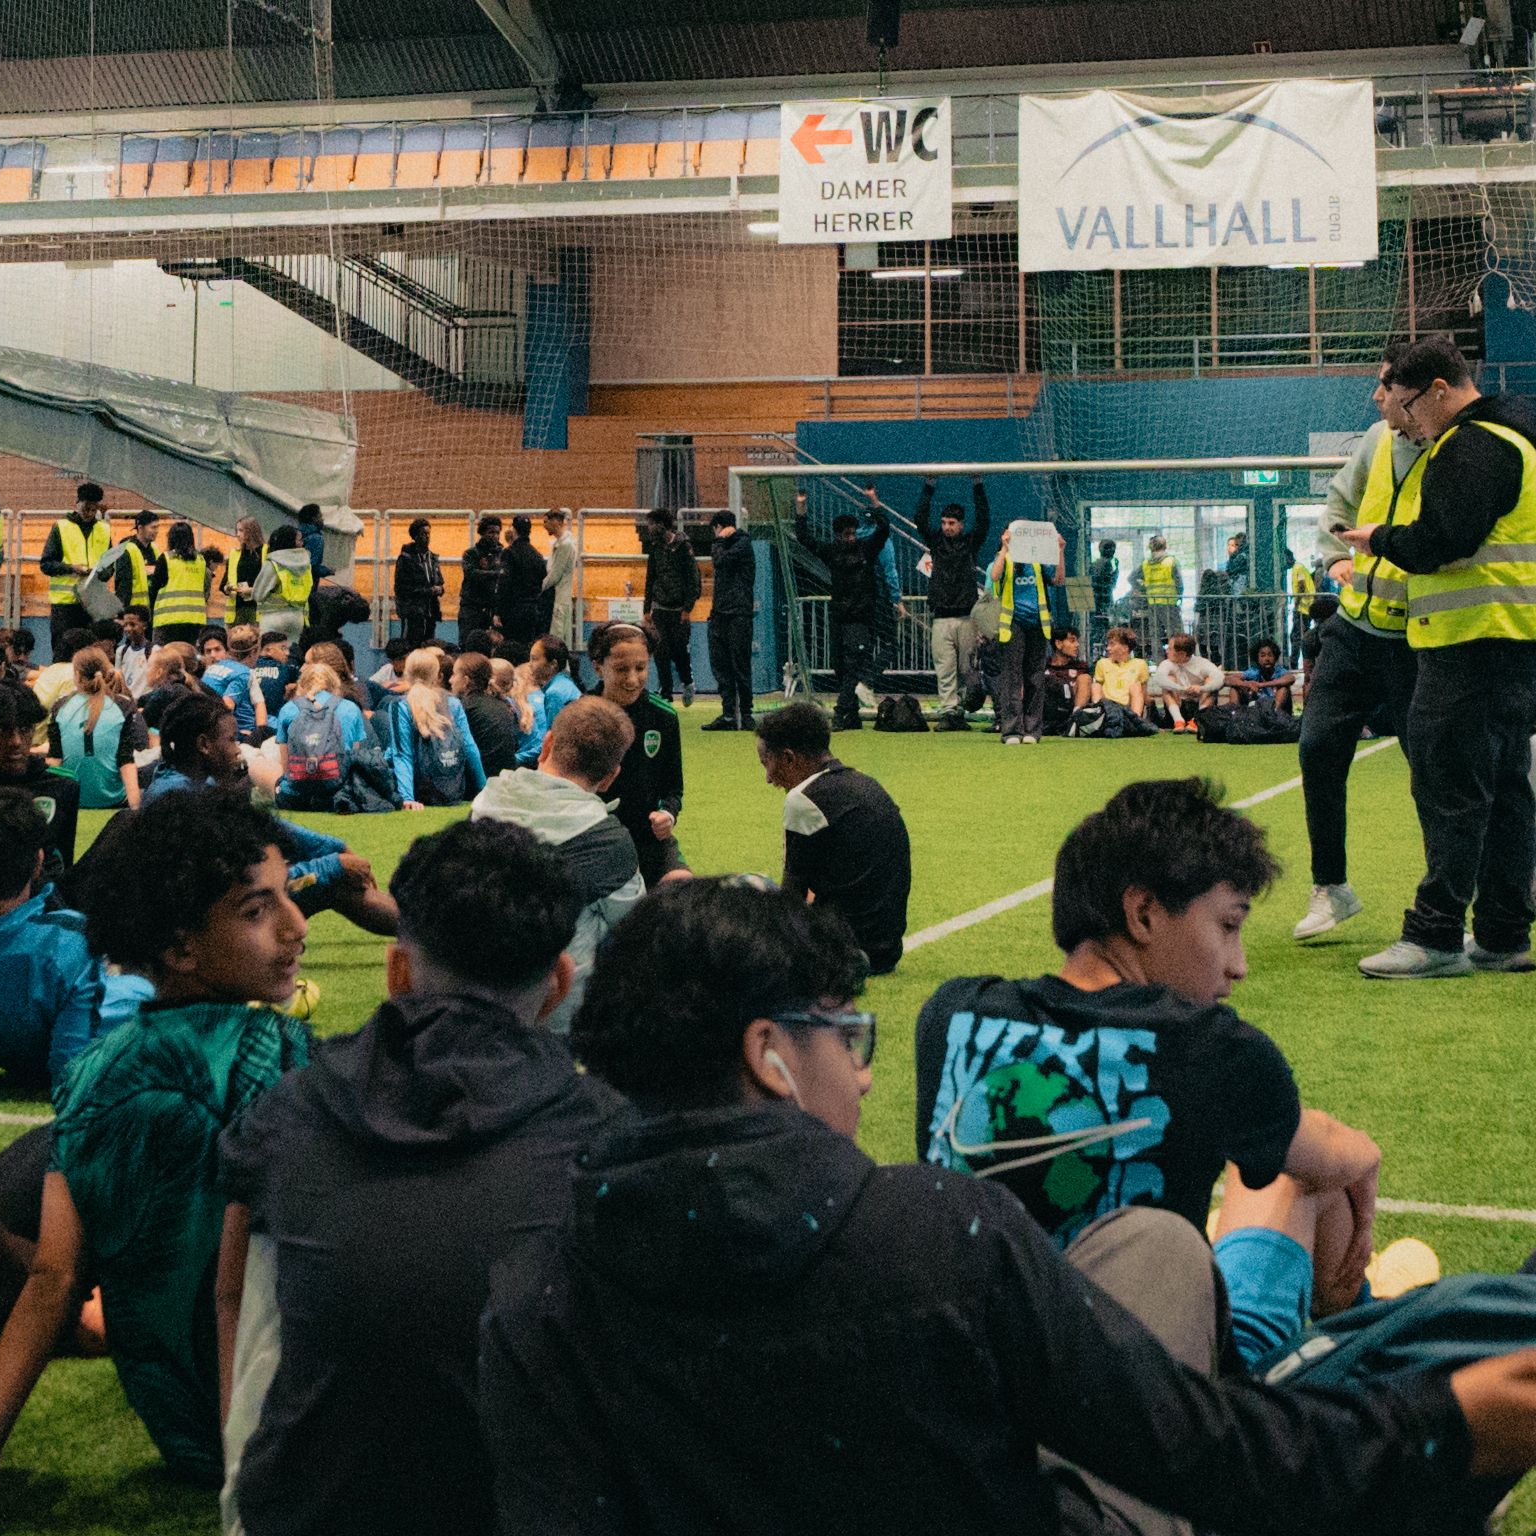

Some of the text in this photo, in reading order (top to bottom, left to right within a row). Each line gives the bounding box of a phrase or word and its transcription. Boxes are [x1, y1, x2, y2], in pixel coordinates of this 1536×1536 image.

[859, 107, 938, 164] WC
[821, 179, 907, 200] DAMER
[814, 211, 913, 232] HERRER
[1055, 198, 1316, 250] VALLHALL
[1329, 195, 1341, 242] arena
